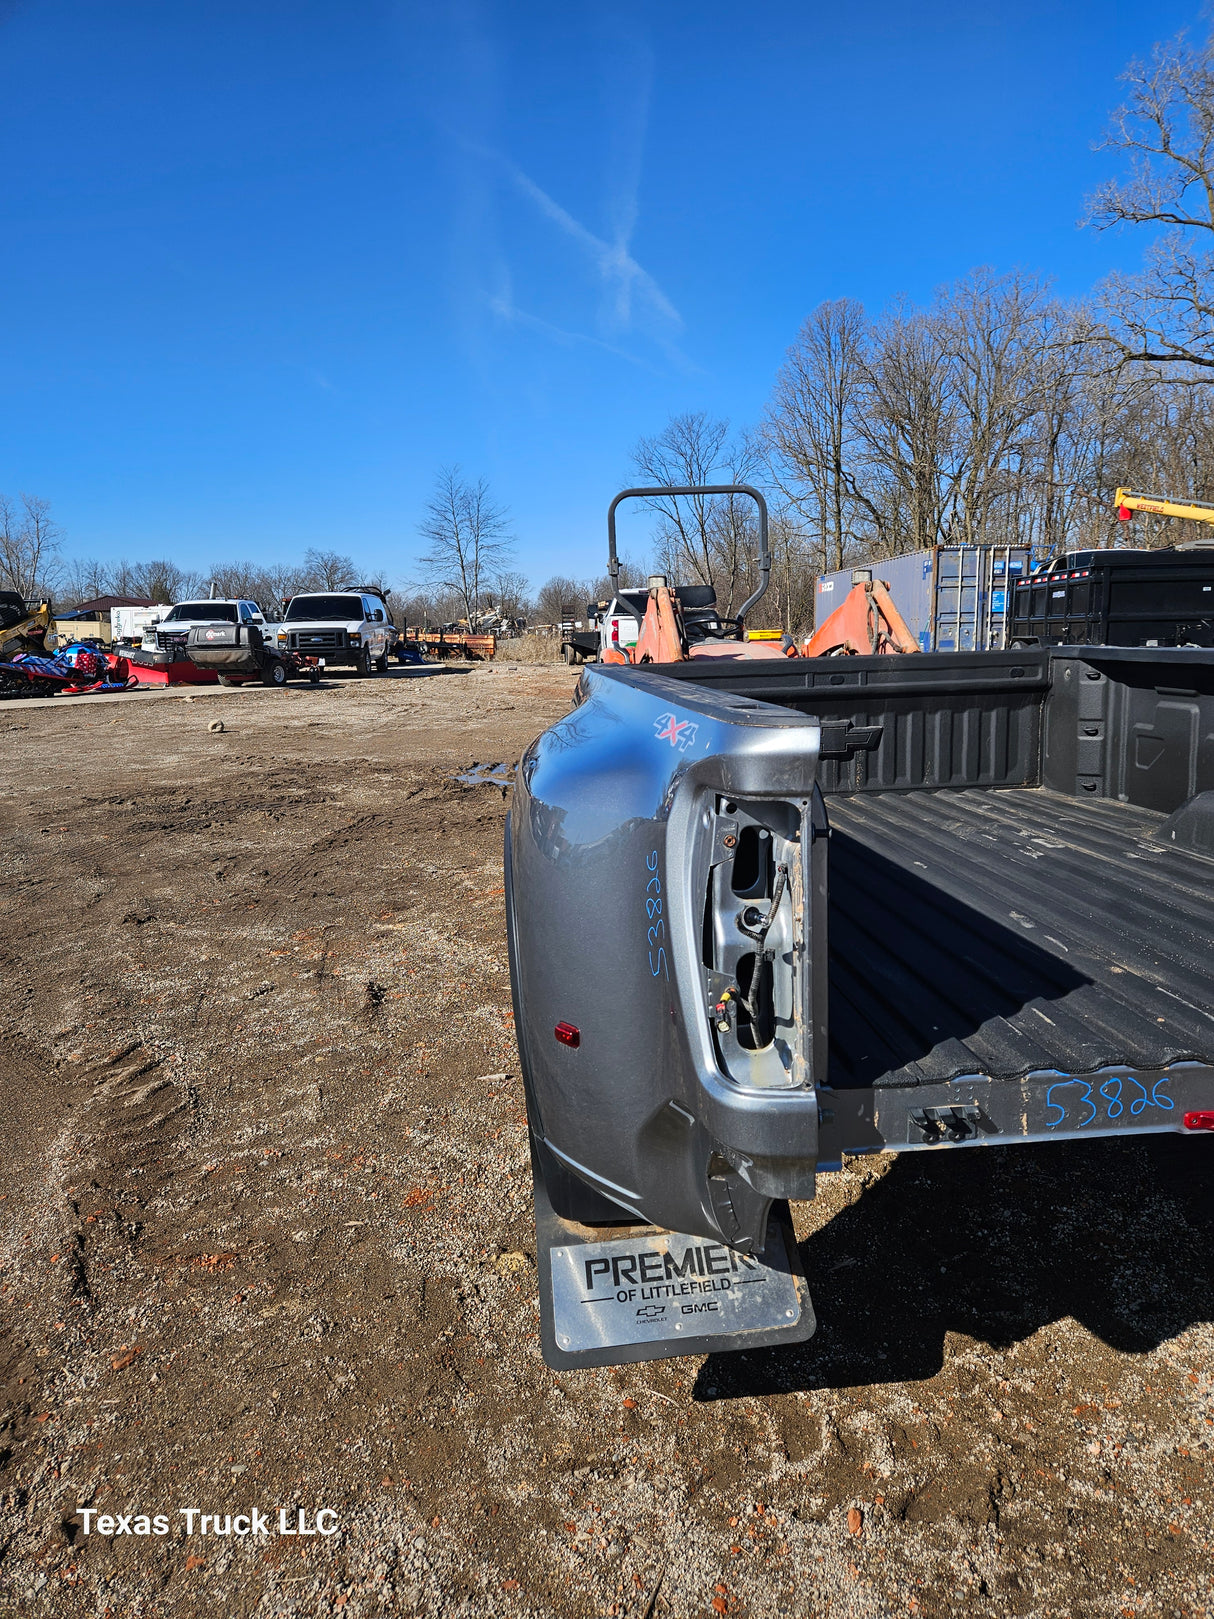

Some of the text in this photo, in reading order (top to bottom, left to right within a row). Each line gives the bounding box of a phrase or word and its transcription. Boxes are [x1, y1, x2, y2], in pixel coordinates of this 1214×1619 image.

[645, 849, 670, 982] 53826
[1046, 1077, 1175, 1127] 53826
[584, 1244, 757, 1290] PREMIER
[616, 1278, 732, 1303] OF LITTLEFIELD
[681, 1301, 719, 1315] GMC
[636, 1317, 668, 1325] CHEVROLET
